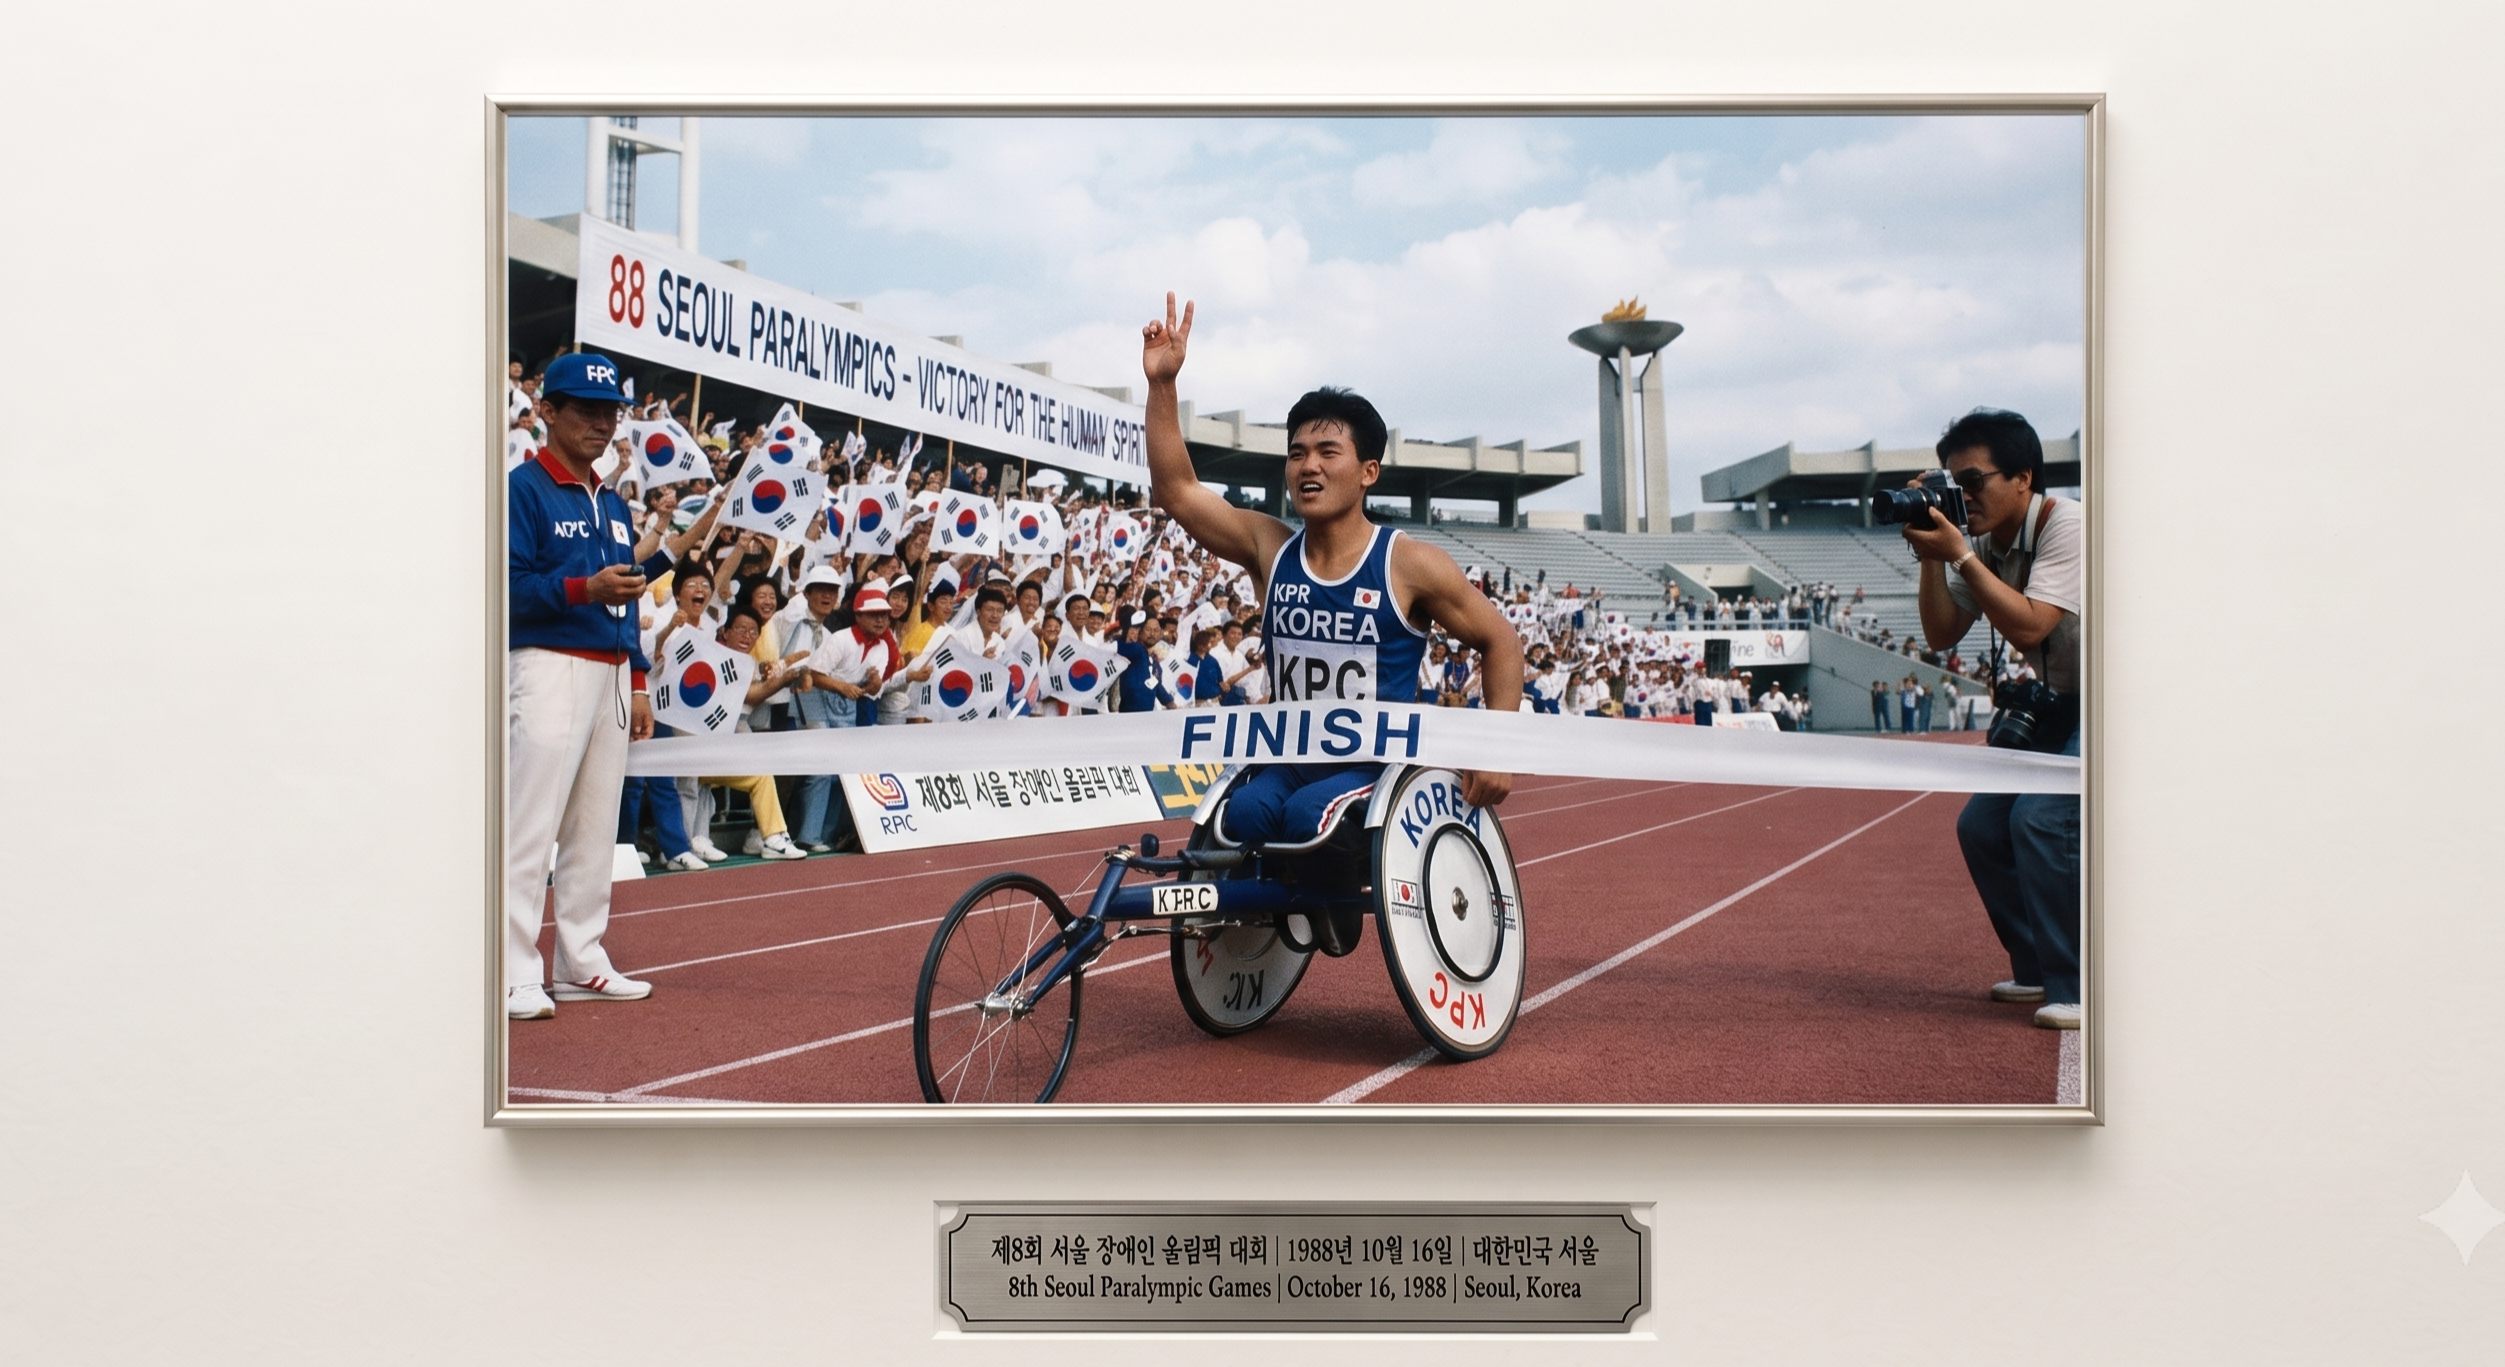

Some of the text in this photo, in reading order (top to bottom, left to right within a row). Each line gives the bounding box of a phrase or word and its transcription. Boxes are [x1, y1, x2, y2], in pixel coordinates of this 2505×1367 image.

[586, 365, 616, 386] FPC
[609, 254, 645, 329] 88
[657, 268, 740, 358] SEOUL
[750, 300, 896, 401] PARALYMPICS
[918, 356, 989, 426] VICTORY
[995, 381, 1025, 436] FOR
[1030, 392, 1056, 444] THE
[1061, 402, 1109, 458] HUMAN
[1274, 583, 1310, 604] KPR
[1272, 606, 1380, 643] KOREA
[1279, 653, 1367, 701] KPC
[1181, 708, 1421, 759] FINISH
[915, 773, 972, 813] 제8회
[973, 771, 1012, 808] 서울
[1008, 768, 1064, 806] 장애인
[1063, 766, 1112, 803] 올림픽
[1107, 765, 1141, 796] 대회
[1400, 782, 1480, 849] KOREA
[1430, 971, 1486, 1030] KPC
[991, 1235, 1042, 1266] 제8회
[1051, 1235, 1090, 1266] 서울
[1096, 1235, 1155, 1266] 장애인
[1162, 1235, 1222, 1266] 올림픽
[1229, 1235, 1268, 1266] 대회
[1288, 1235, 1353, 1266] 1988년
[1361, 1235, 1404, 1266] 10월
[1411, 1235, 1453, 1266] 16일
[1472, 1235, 1554, 1267] 대한민국
[1558, 1235, 1600, 1267] 서울
[1008, 1275, 1039, 1298] 8th
[1044, 1274, 1095, 1298] Seoul
[1100, 1275, 1203, 1304] Paralympic
[1208, 1275, 1272, 1298] Games
[1287, 1275, 1363, 1299] October
[1369, 1276, 1396, 1301] 16,
[1403, 1276, 1447, 1298] 1988
[1464, 1275, 1521, 1302] Seoul,
[1526, 1276, 1582, 1299] Korea
